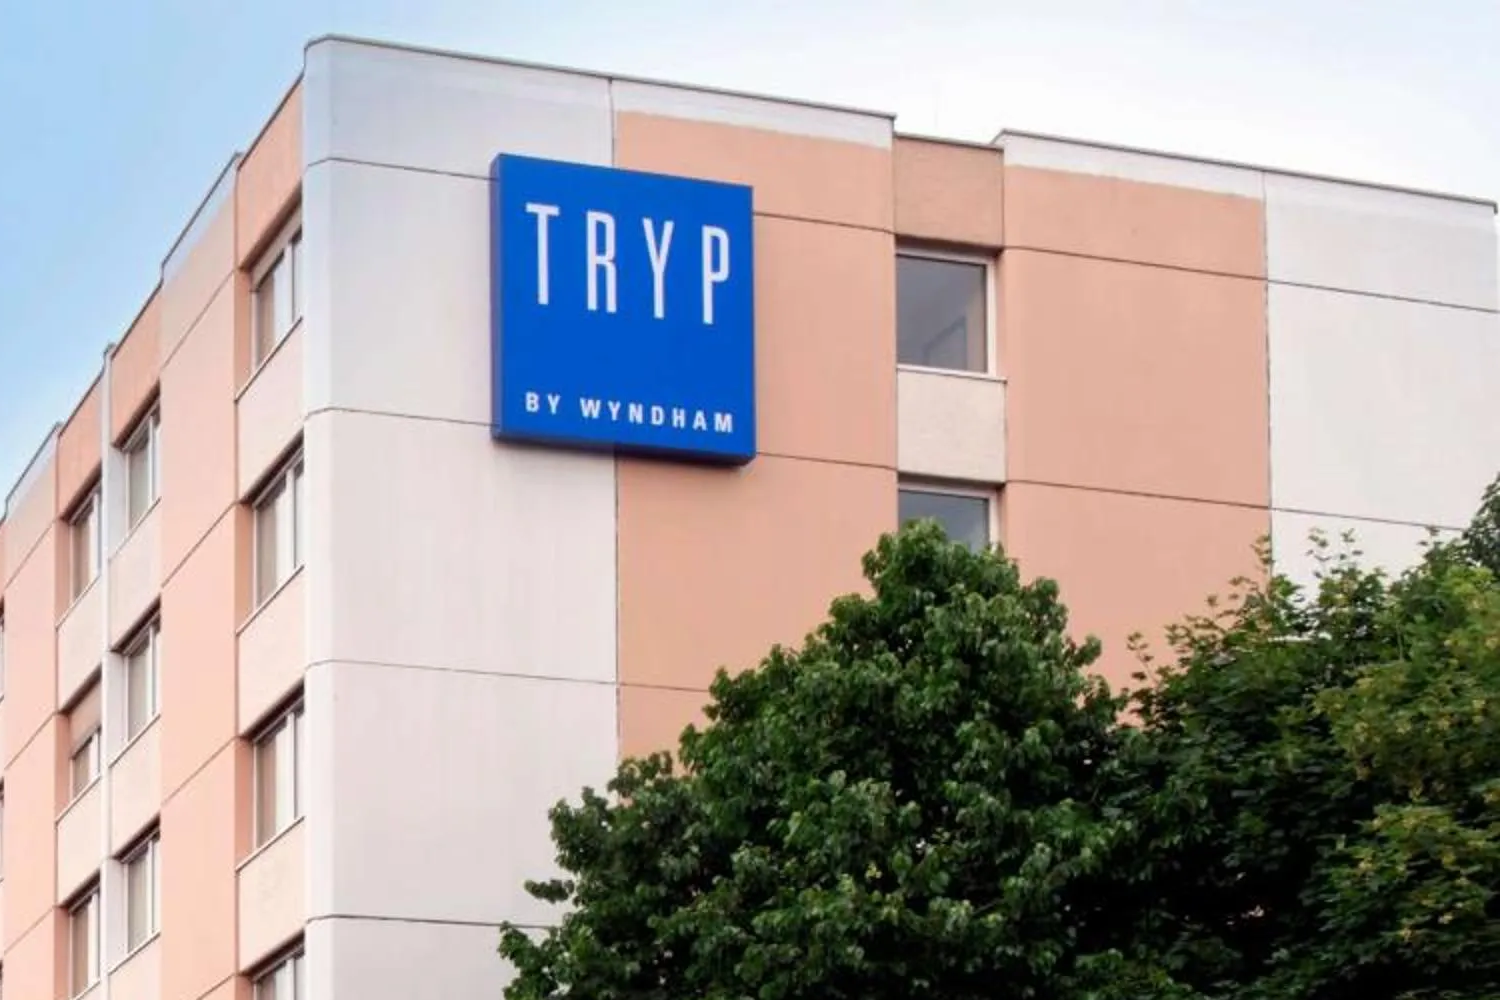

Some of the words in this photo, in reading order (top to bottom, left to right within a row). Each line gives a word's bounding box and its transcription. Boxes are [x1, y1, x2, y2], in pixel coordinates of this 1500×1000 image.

[526, 202, 730, 325] TRYP
[525, 392, 561, 414] BY
[580, 398, 733, 433] WYNDHAM
